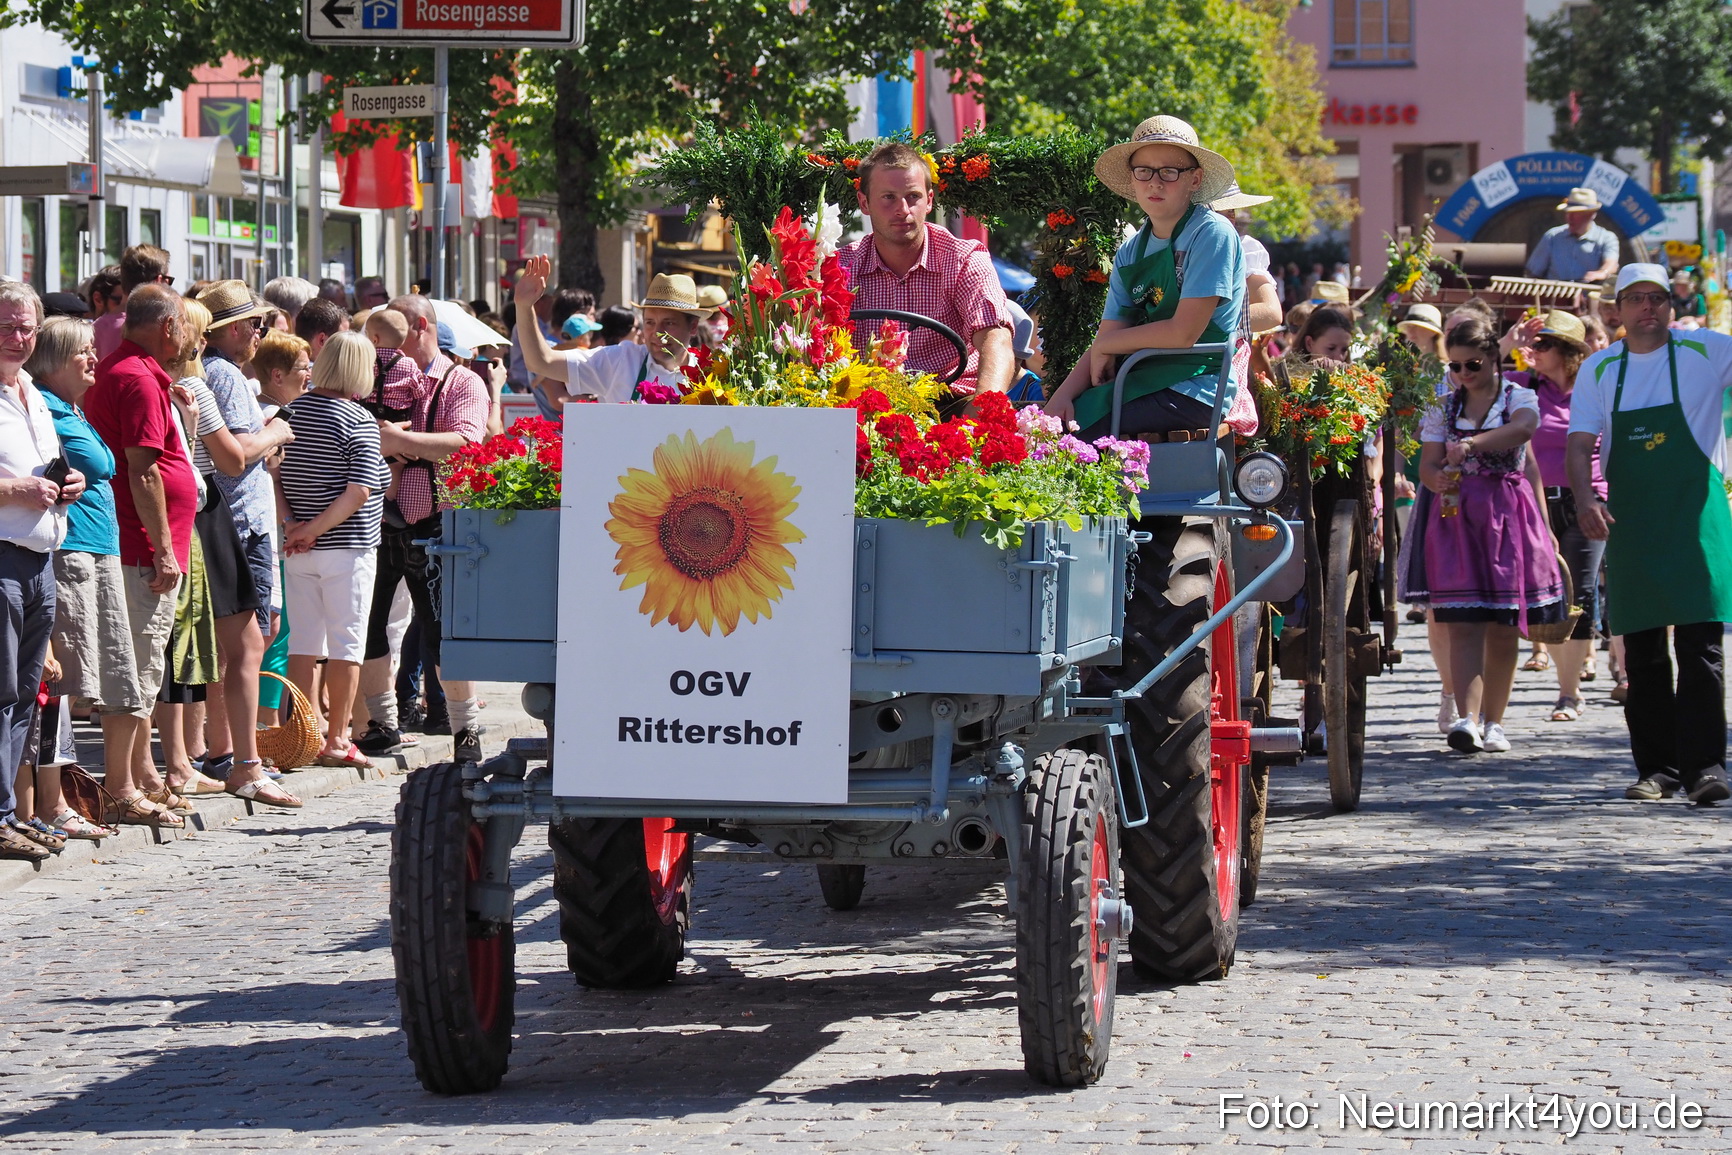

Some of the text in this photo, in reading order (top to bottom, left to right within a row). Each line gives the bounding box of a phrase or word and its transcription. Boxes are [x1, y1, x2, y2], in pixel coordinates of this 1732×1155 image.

[416, 0, 530, 27] Rosengasse
[352, 94, 426, 114] Rosengasse
[1516, 158, 1584, 173] PÖLLING
[1479, 169, 1507, 192] 950
[1595, 168, 1621, 188] 950
[669, 669, 752, 697] OGV
[618, 716, 803, 746] Rittershof
